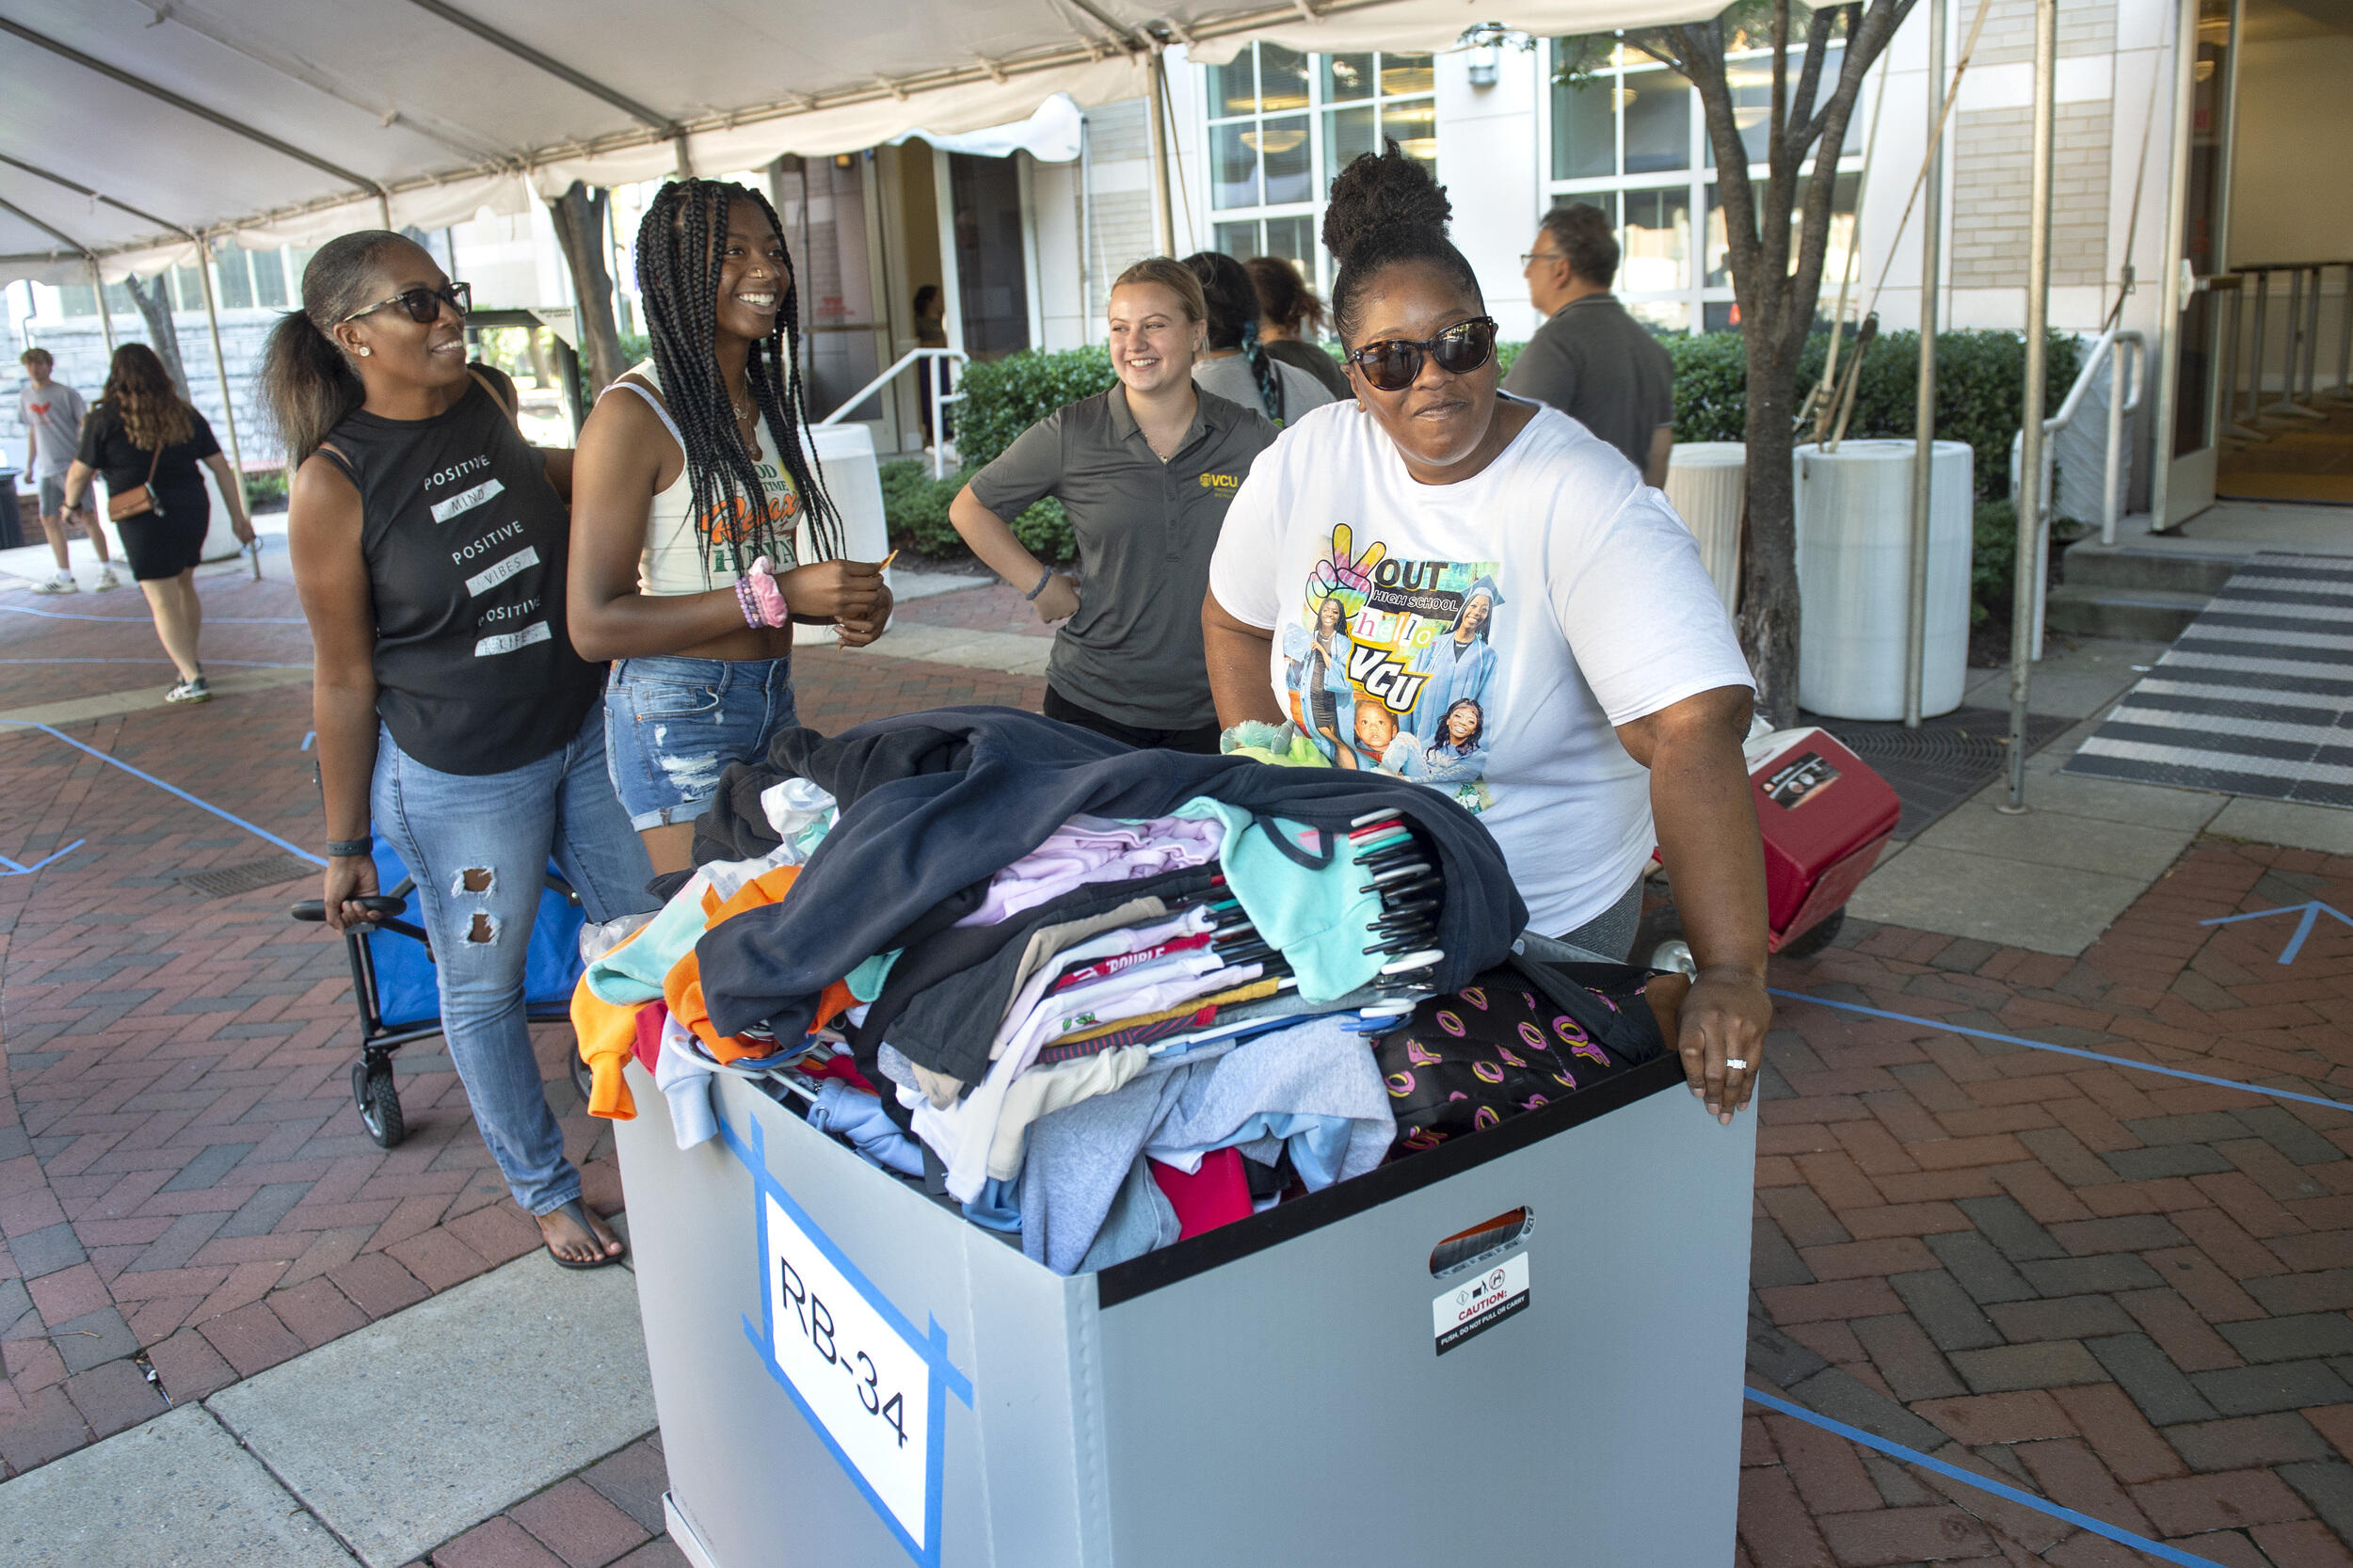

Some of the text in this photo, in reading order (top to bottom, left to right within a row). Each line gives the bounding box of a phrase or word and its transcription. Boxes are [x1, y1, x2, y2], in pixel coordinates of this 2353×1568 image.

[424, 455, 490, 491] POSITIVE
[1211, 473, 1239, 488] VCU
[450, 488, 486, 513] MIND
[451, 520, 524, 566] POSITIVE
[484, 557, 521, 584] VIBES
[1374, 557, 1449, 591] OUT
[1372, 589, 1459, 612] HIGH SCHOOL
[1348, 643, 1430, 712] VCU
[1459, 1327, 1469, 1336] DO
[1469, 1319, 1481, 1330] NOT
[1481, 1312, 1497, 1324] PULL
[1497, 1306, 1506, 1315] OR
[1506, 1296, 1525, 1310] CARRY
[780, 1256, 908, 1449] RB-34
